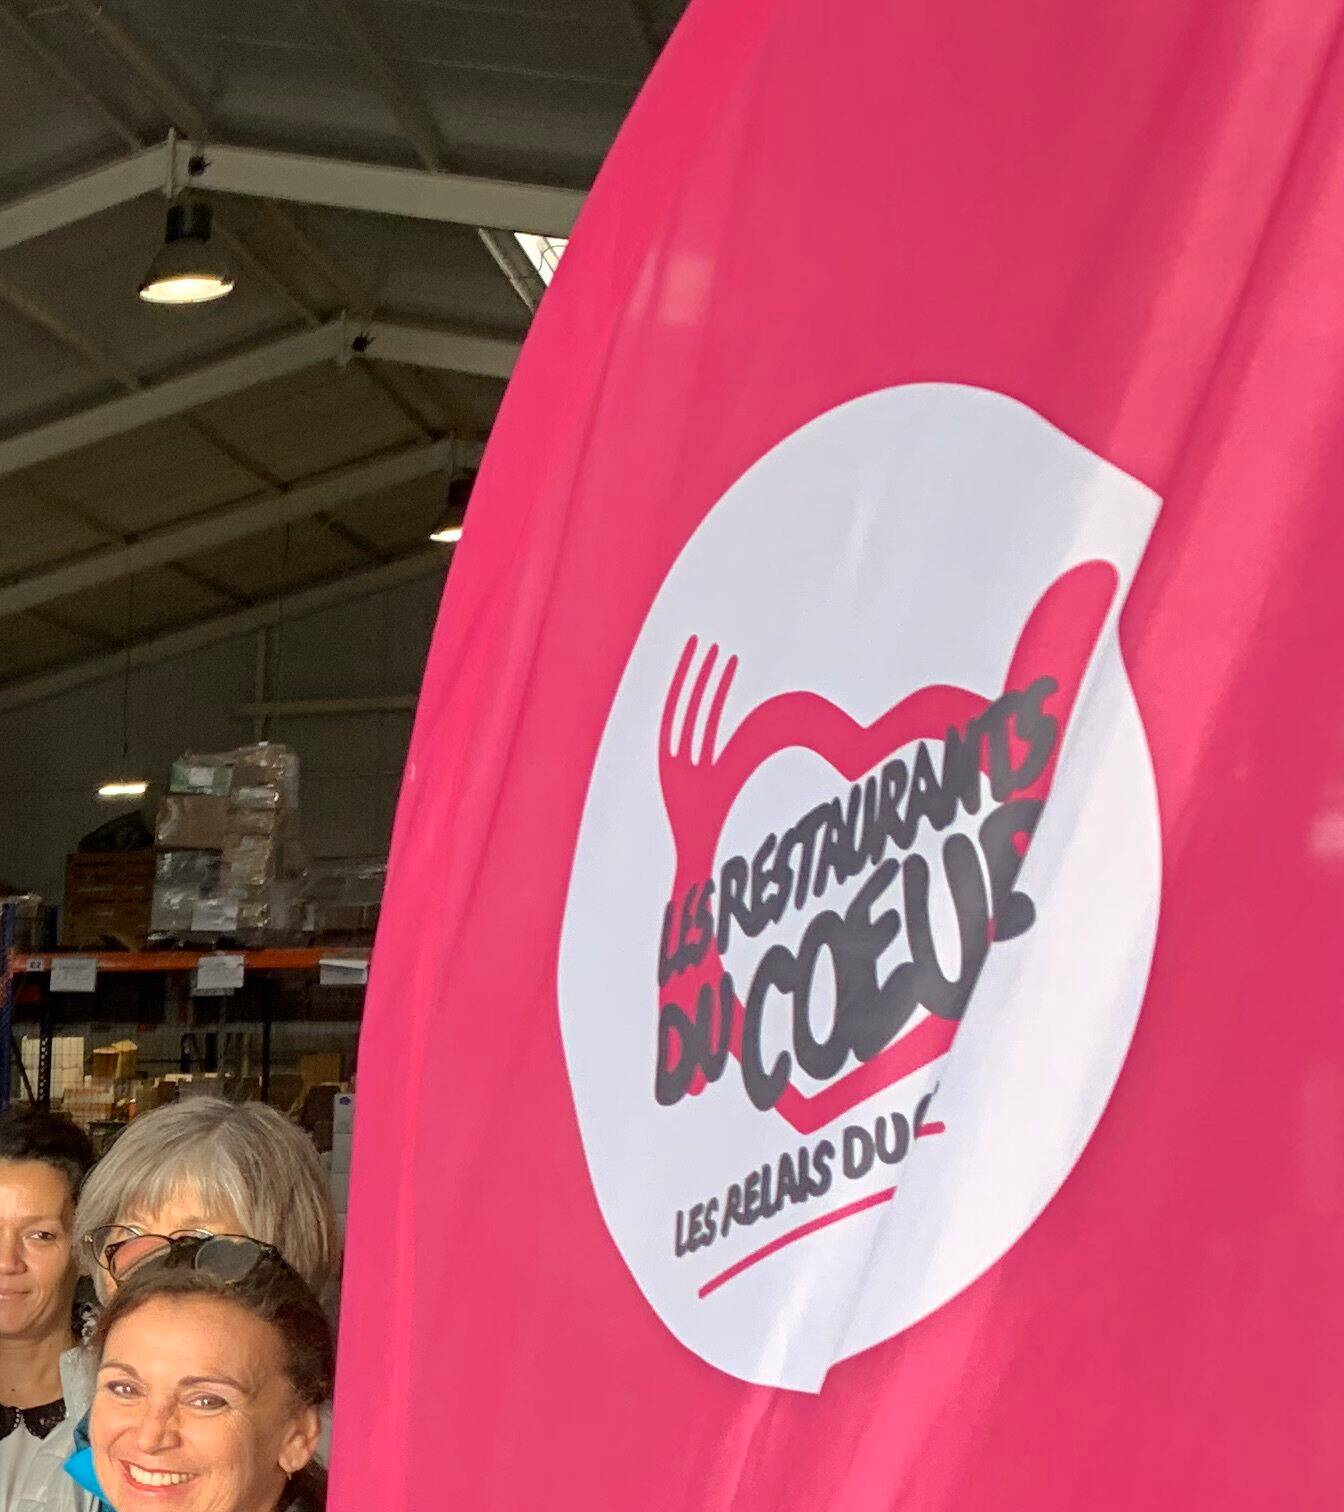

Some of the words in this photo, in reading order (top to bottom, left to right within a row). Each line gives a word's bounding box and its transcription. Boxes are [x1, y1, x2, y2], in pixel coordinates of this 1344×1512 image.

[658, 878, 716, 988] LES
[717, 675, 1059, 954] RESTAURANTS
[655, 971, 735, 1106] DU
[675, 1197, 718, 1257] LES
[721, 1139, 836, 1238] RELAIS
[842, 1112, 911, 1180] DU
